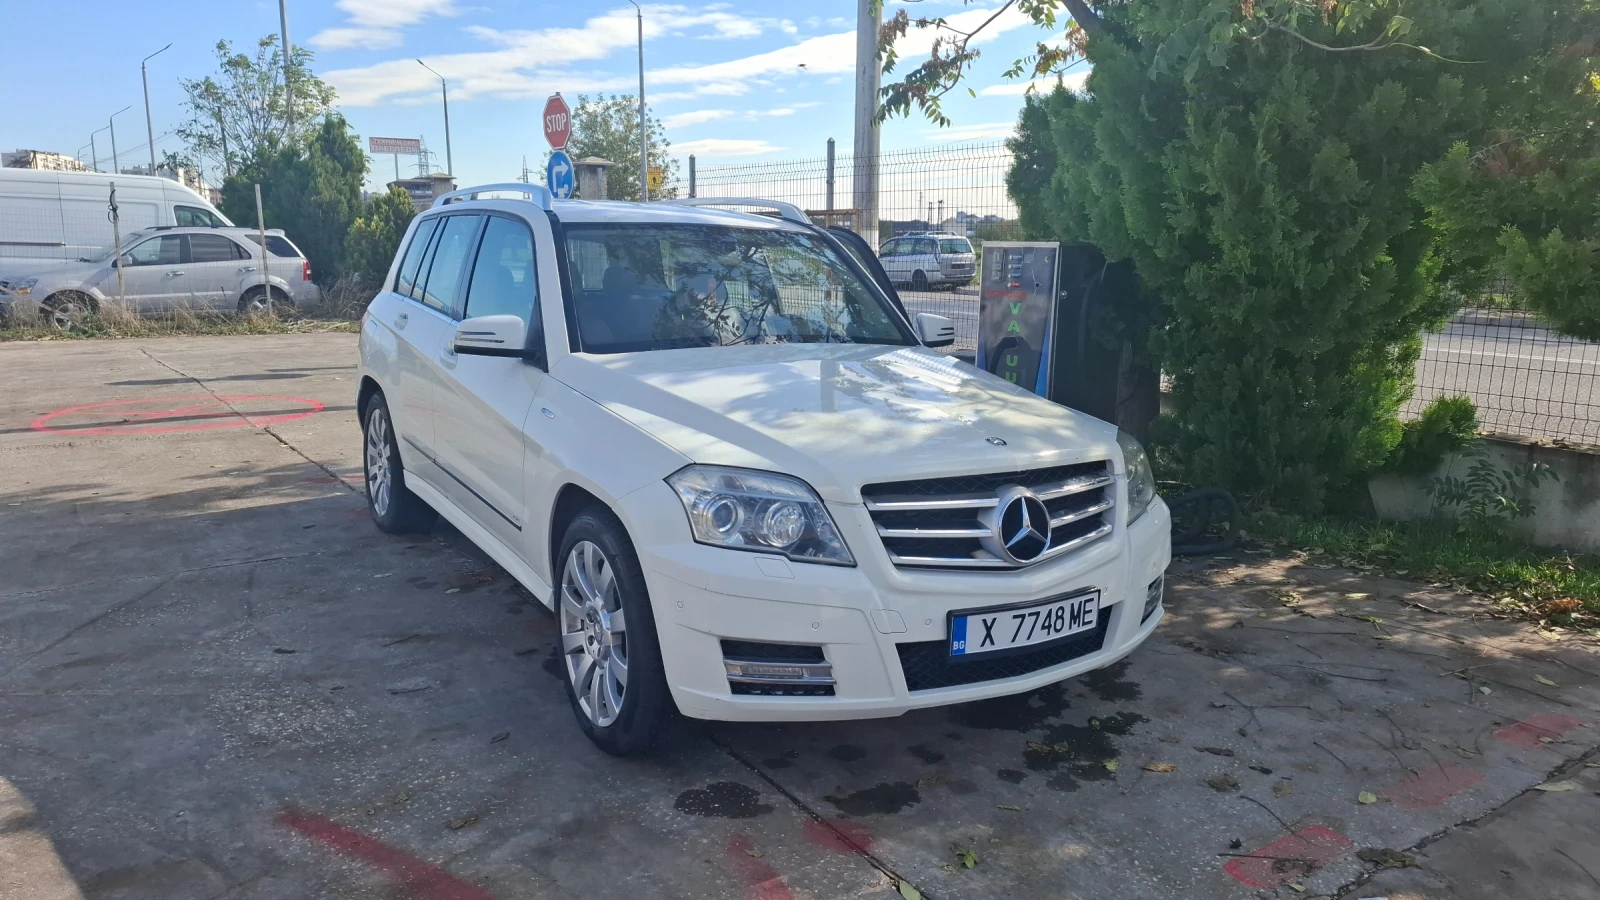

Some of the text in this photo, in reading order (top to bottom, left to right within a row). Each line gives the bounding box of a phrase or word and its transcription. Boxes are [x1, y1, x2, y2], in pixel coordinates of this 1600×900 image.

[546, 113, 567, 133] STOP
[371, 145, 419, 154] ПРЕГЛЕДИ
[980, 598, 1095, 647] X 7748 ME
[953, 640, 965, 650] BG
